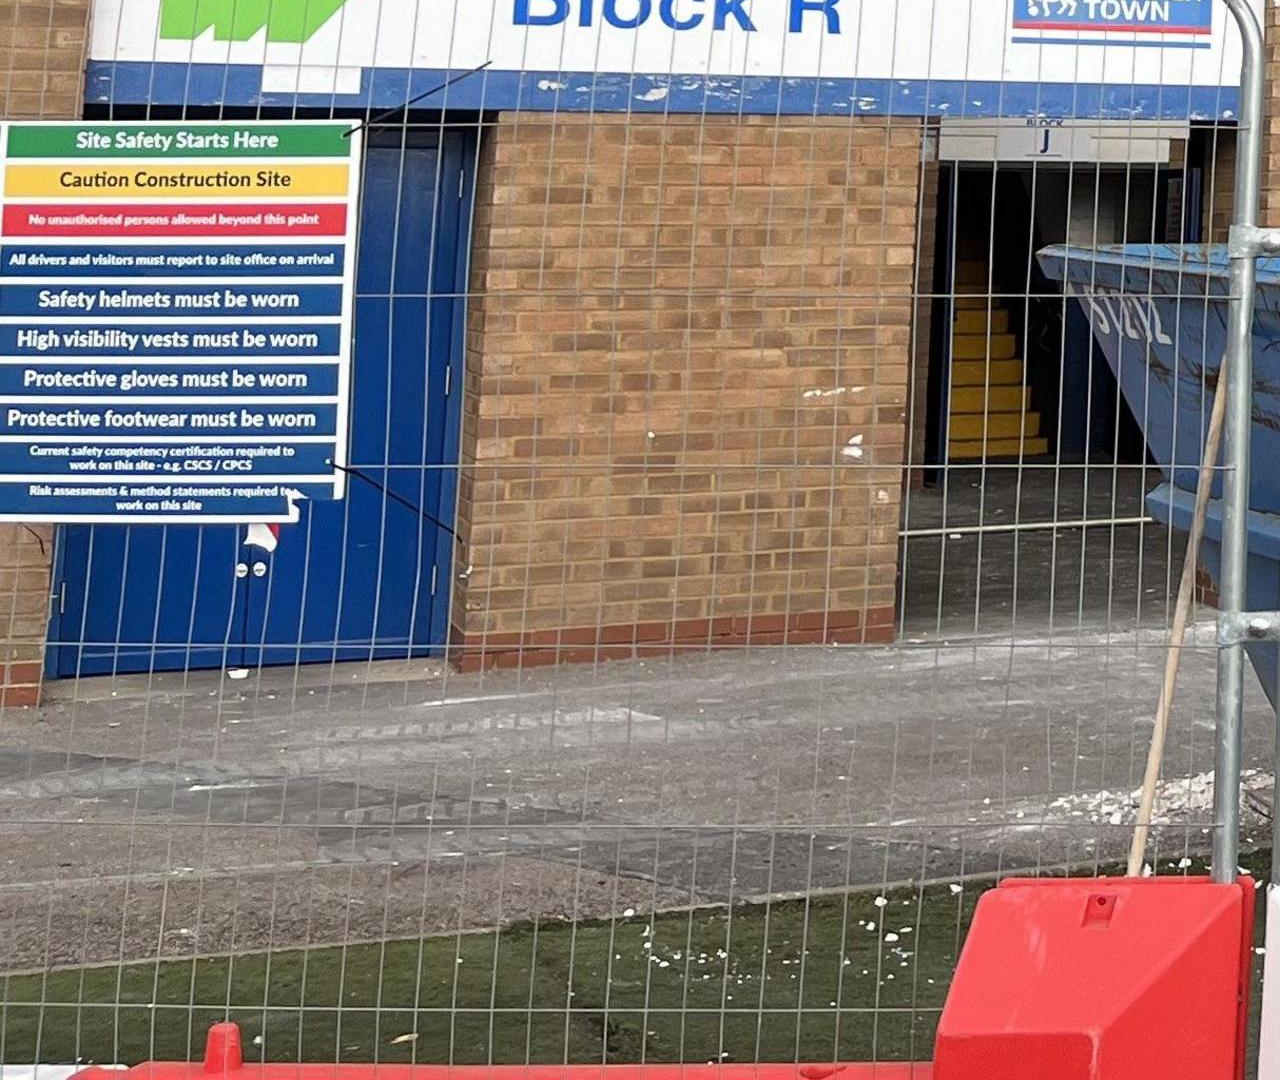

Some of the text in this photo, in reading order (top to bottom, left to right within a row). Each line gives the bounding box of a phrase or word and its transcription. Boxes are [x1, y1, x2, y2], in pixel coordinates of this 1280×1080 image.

[1082, 0, 1171, 22] TOWN
[75, 130, 279, 152] Site Safety Starts Here
[1039, 128, 1050, 154] J
[59, 170, 292, 188] Caution Construction Site
[29, 213, 319, 227] No unauthorised persons allowed beyond this point
[8, 253, 335, 268] All drivers and visitors must report to site office on arrival
[38, 289, 300, 311] Safety helmets must be worn
[16, 329, 319, 351] High visibility vests must be worn
[23, 369, 308, 391] Protective gloves must be worn
[7, 409, 316, 428] Protective footwear must be worn
[29, 445, 295, 458] Current safety competency certification required to
[69, 459, 97, 471] work
[98, 461, 113, 471] on
[114, 459, 134, 471] this
[135, 459, 156, 471] site
[163, 461, 182, 473] e.g.
[183, 459, 213, 471] CSCS
[222, 459, 253, 471] CPCS
[29, 485, 52, 496] Risk
[53, 486, 118, 497] assessments
[119, 485, 129, 497] &
[130, 485, 171, 497] method
[172, 486, 232, 497] statements
[233, 485, 278, 498] required
[115, 499, 202, 511] work on this site
